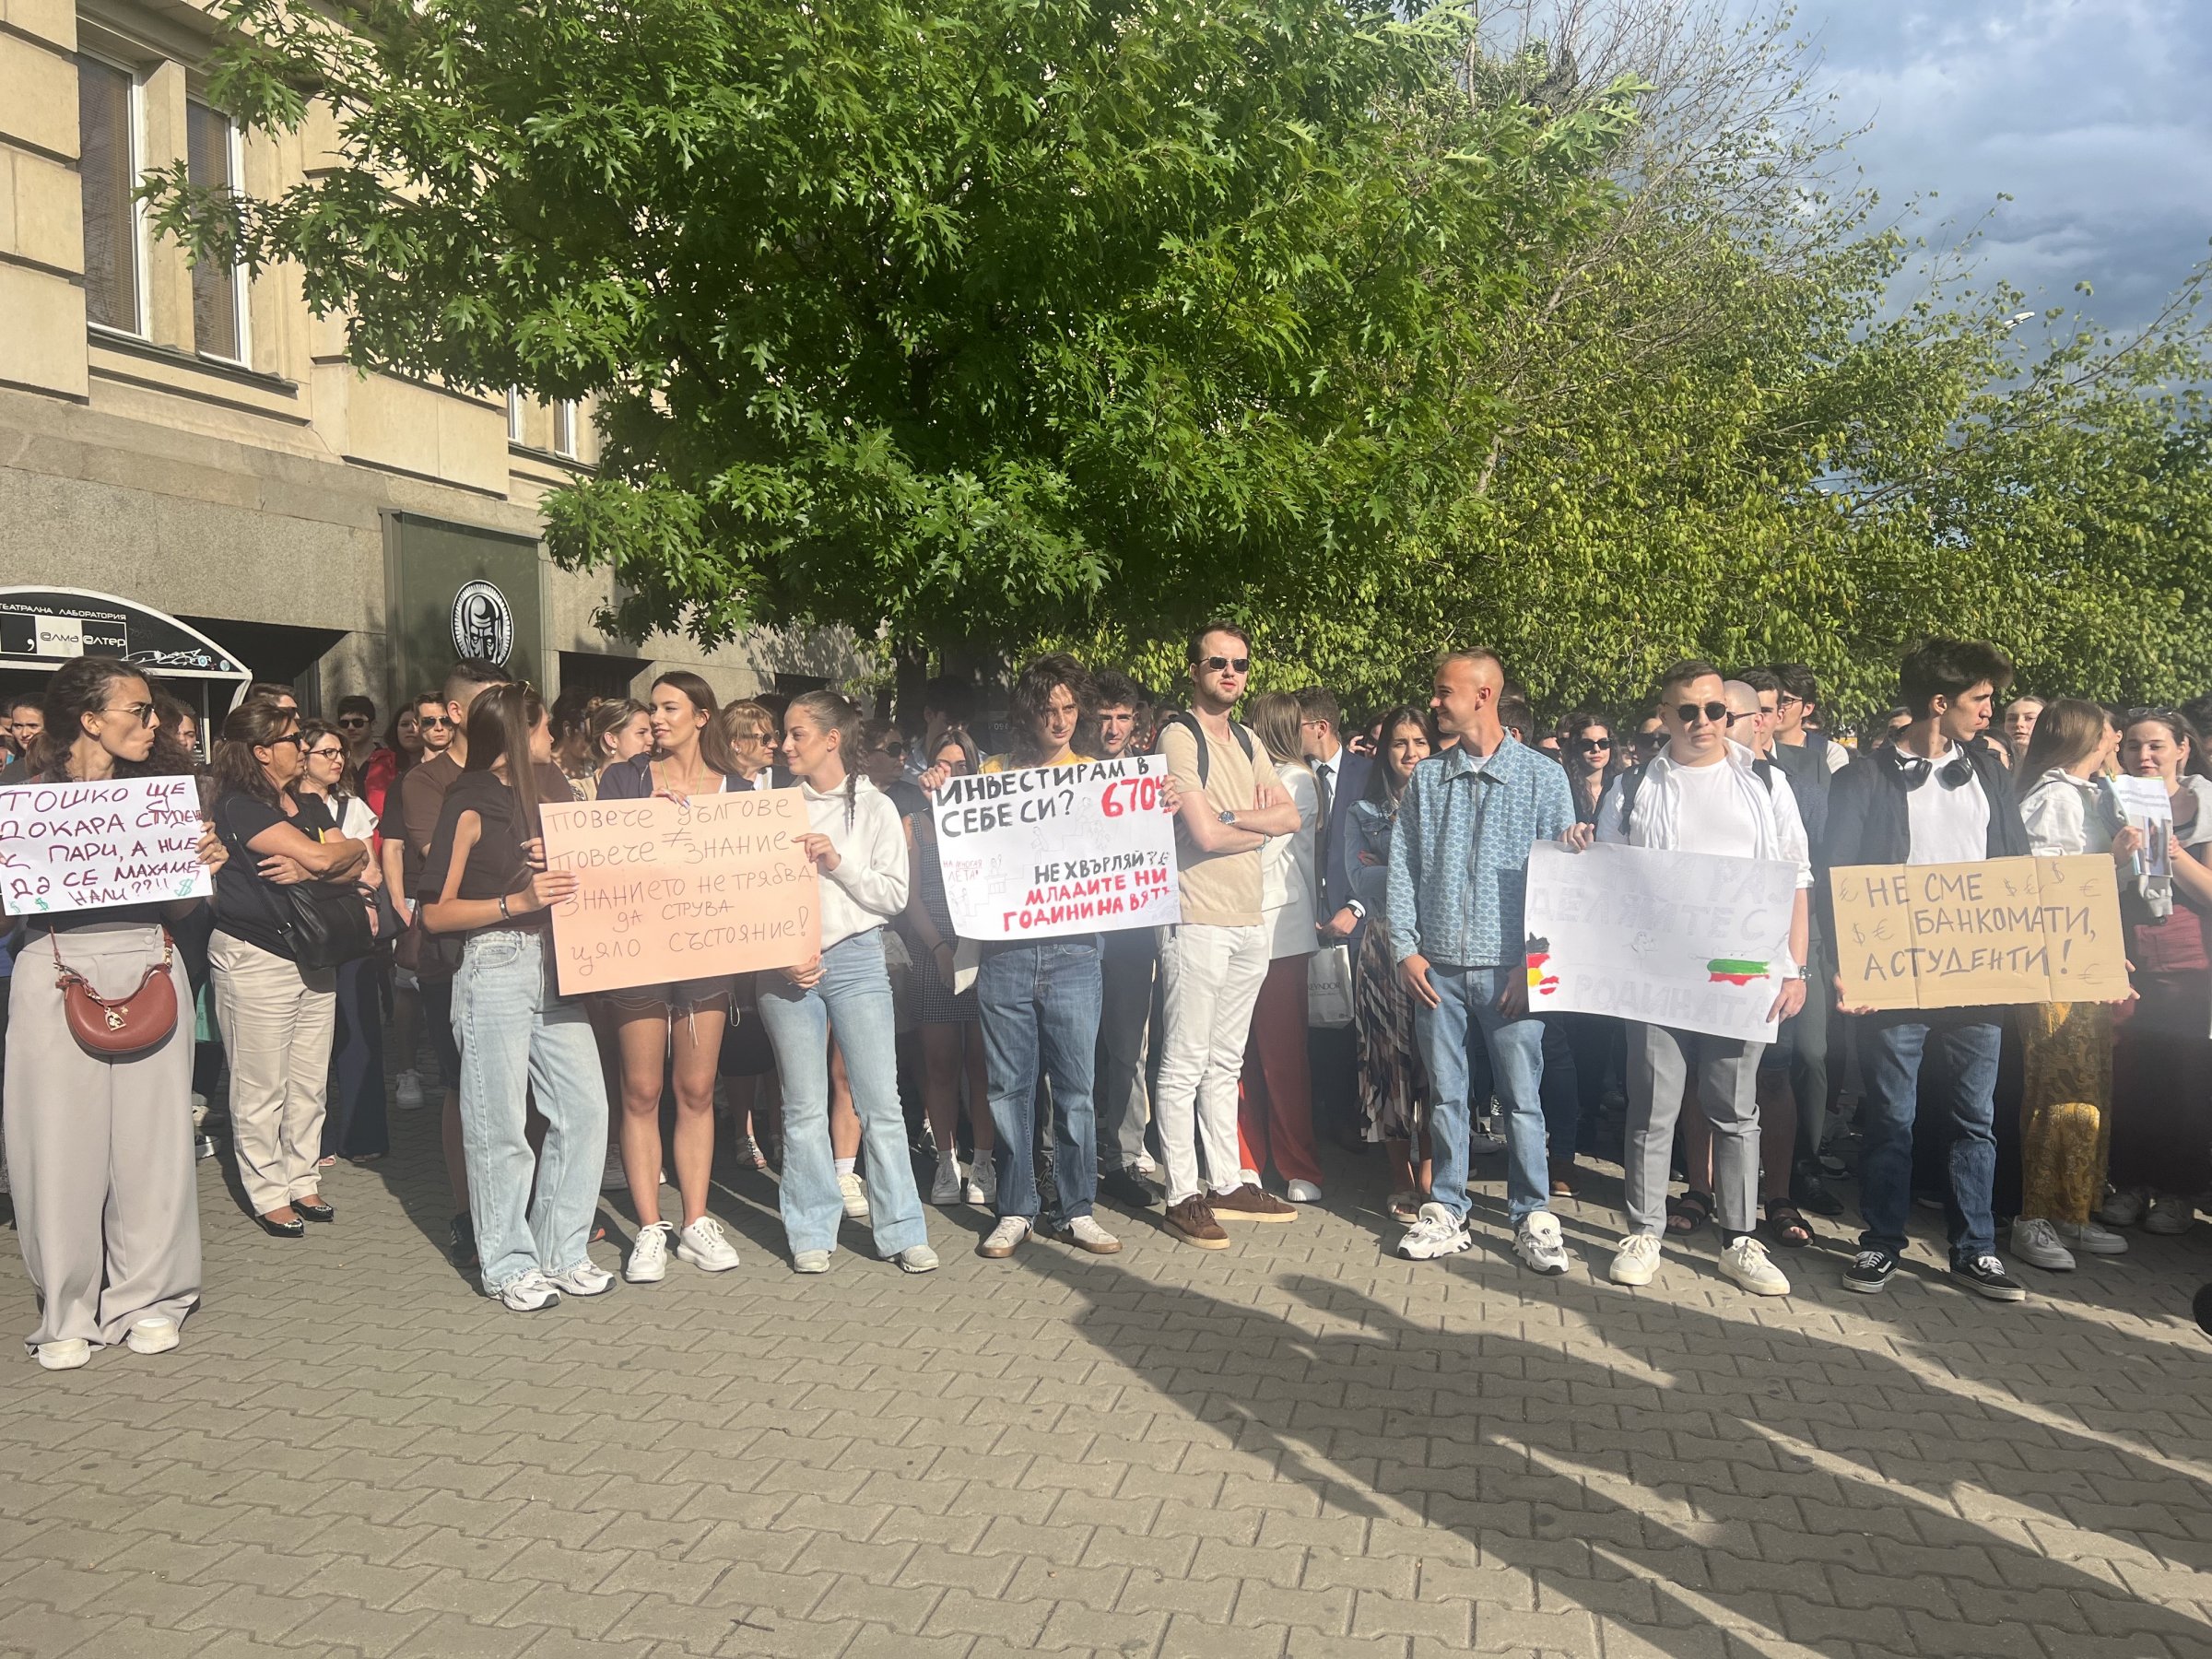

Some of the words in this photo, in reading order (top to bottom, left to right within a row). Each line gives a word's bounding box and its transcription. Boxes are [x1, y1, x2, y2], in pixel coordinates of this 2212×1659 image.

[59, 608, 126, 620] ЛАБОРАТОРИЯ
[0, 788, 128, 812] ТОШКО
[146, 782, 185, 813] ЩЕ
[936, 759, 1125, 806] ИНВЕСТИРАМ
[1137, 757, 1149, 774] В
[0, 813, 125, 841] ДОКАРА
[941, 803, 1013, 838] СЕБЕ
[1020, 789, 1074, 823] СИ?
[63, 868, 99, 888] СЕ
[1025, 877, 1126, 906] МЛАДИТЕ
[1135, 867, 1167, 887] НИ
[1034, 864, 1060, 885] НЕ
[1865, 876, 1909, 908] НЕ
[1924, 873, 1983, 903] СМЕ
[1003, 900, 1094, 932] ГОДИНИ
[1914, 906, 2096, 941] БАНКОМАТИ,
